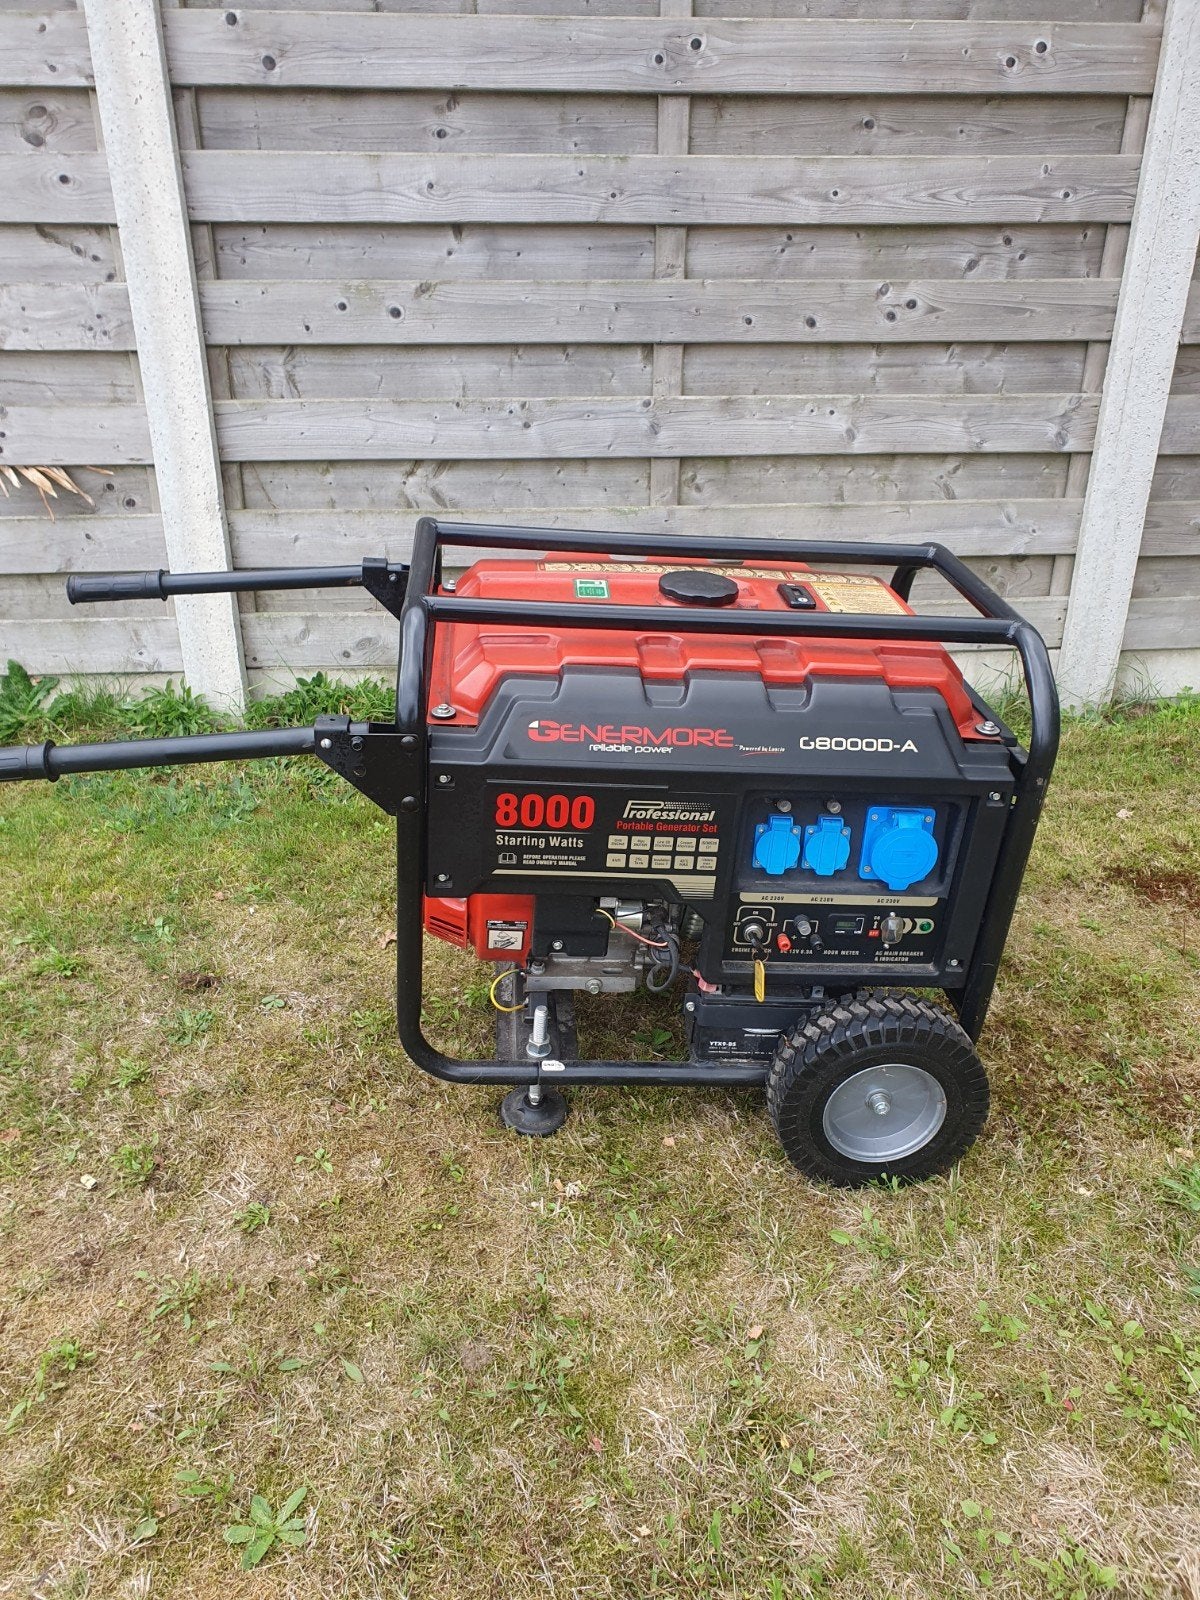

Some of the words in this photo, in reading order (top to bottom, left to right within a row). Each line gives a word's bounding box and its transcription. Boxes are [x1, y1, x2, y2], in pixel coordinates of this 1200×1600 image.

[527, 719, 734, 747] GENERMORE
[588, 743, 632, 753] reliable
[634, 744, 673, 755] power
[799, 736, 919, 753] G8000D-A
[494, 792, 596, 830] 8000
[621, 799, 717, 822] Professional
[616, 821, 655, 831] Portable
[655, 822, 702, 833] Generator
[702, 823, 719, 833] Set
[496, 834, 546, 848] Starting
[548, 836, 584, 848] Watts
